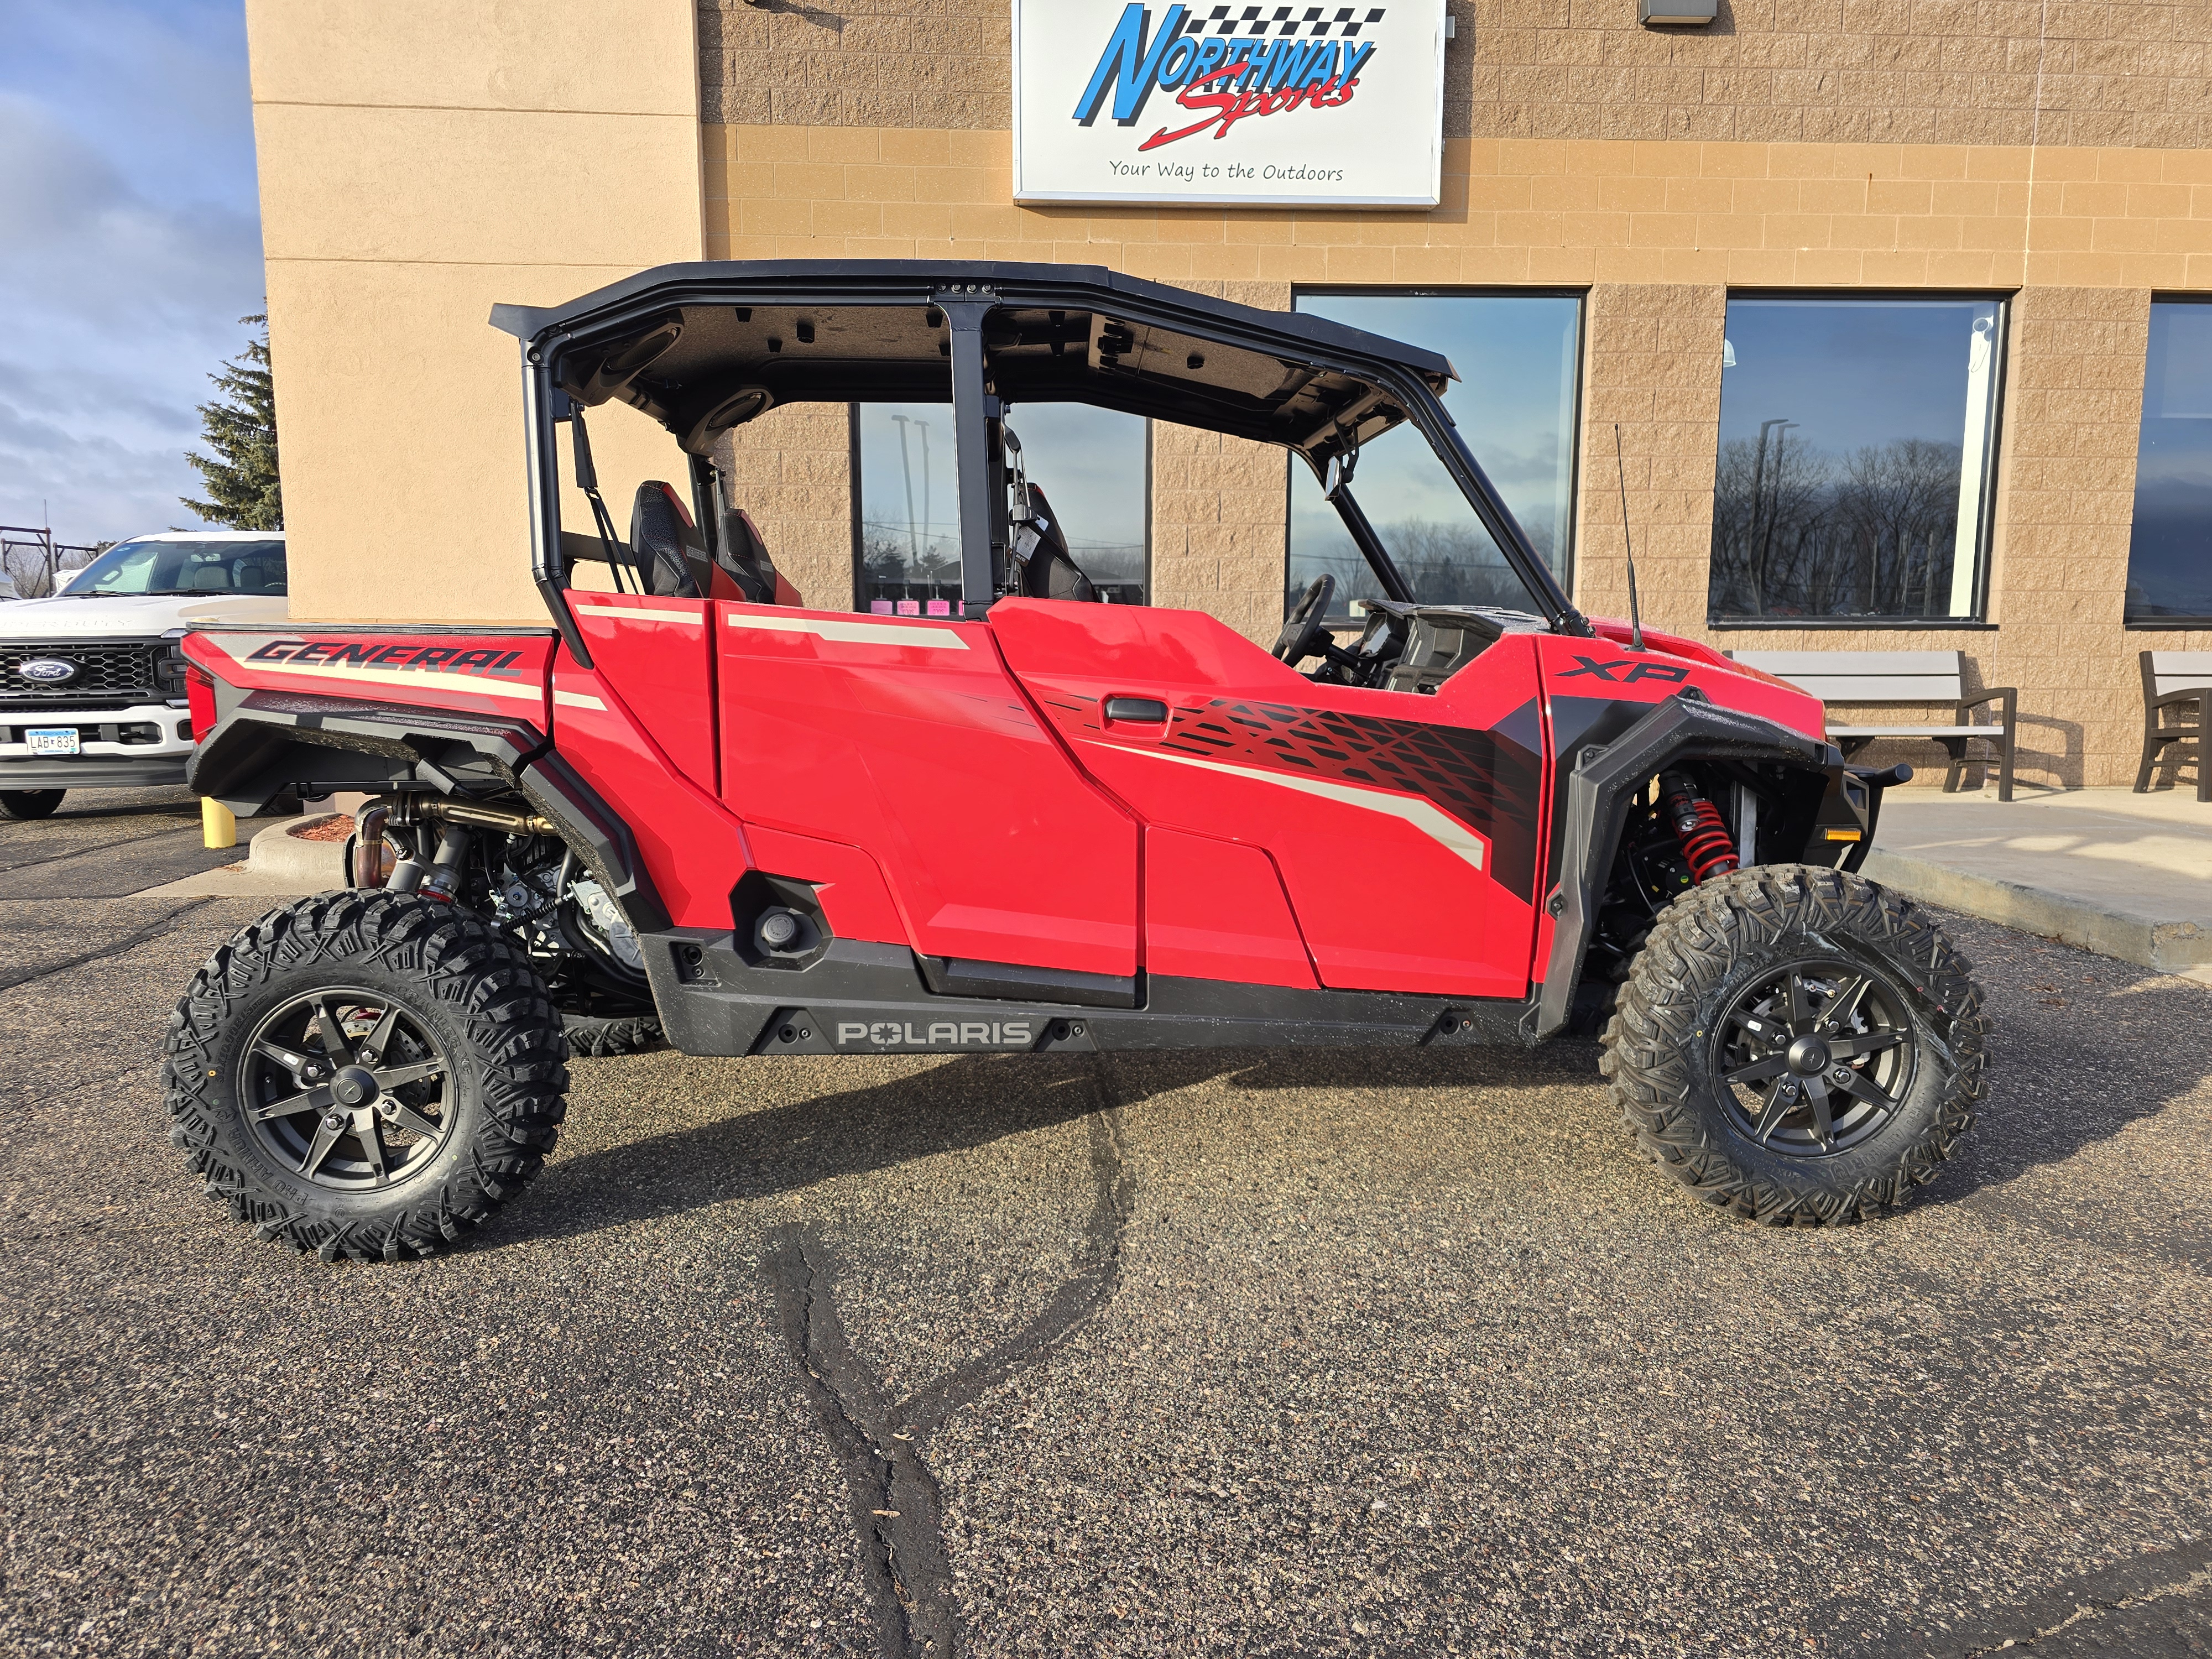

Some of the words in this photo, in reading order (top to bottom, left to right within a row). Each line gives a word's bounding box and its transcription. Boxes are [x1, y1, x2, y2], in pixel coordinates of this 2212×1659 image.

[1072, 3, 1377, 127] NORTHWAY
[1138, 61, 1360, 151] Sports
[1109, 160, 1150, 176] Your
[1157, 162, 1194, 182] Way
[1202, 163, 1219, 178] to
[1227, 163, 1255, 178] the
[1263, 164, 1343, 181] Outdoors
[33, 665, 61, 676] Ford
[244, 640, 525, 677] GENERAL
[1552, 655, 1691, 683] XP
[30, 736, 49, 748] LAB
[57, 736, 75, 748] 835
[838, 1022, 1032, 1045] POLARIS
[1903, 1097, 1932, 1129] PRO
[227, 1126, 274, 1181] ARMOR
[1853, 1128, 1906, 1171] ARMOR
[272, 1179, 308, 1205] PRO
